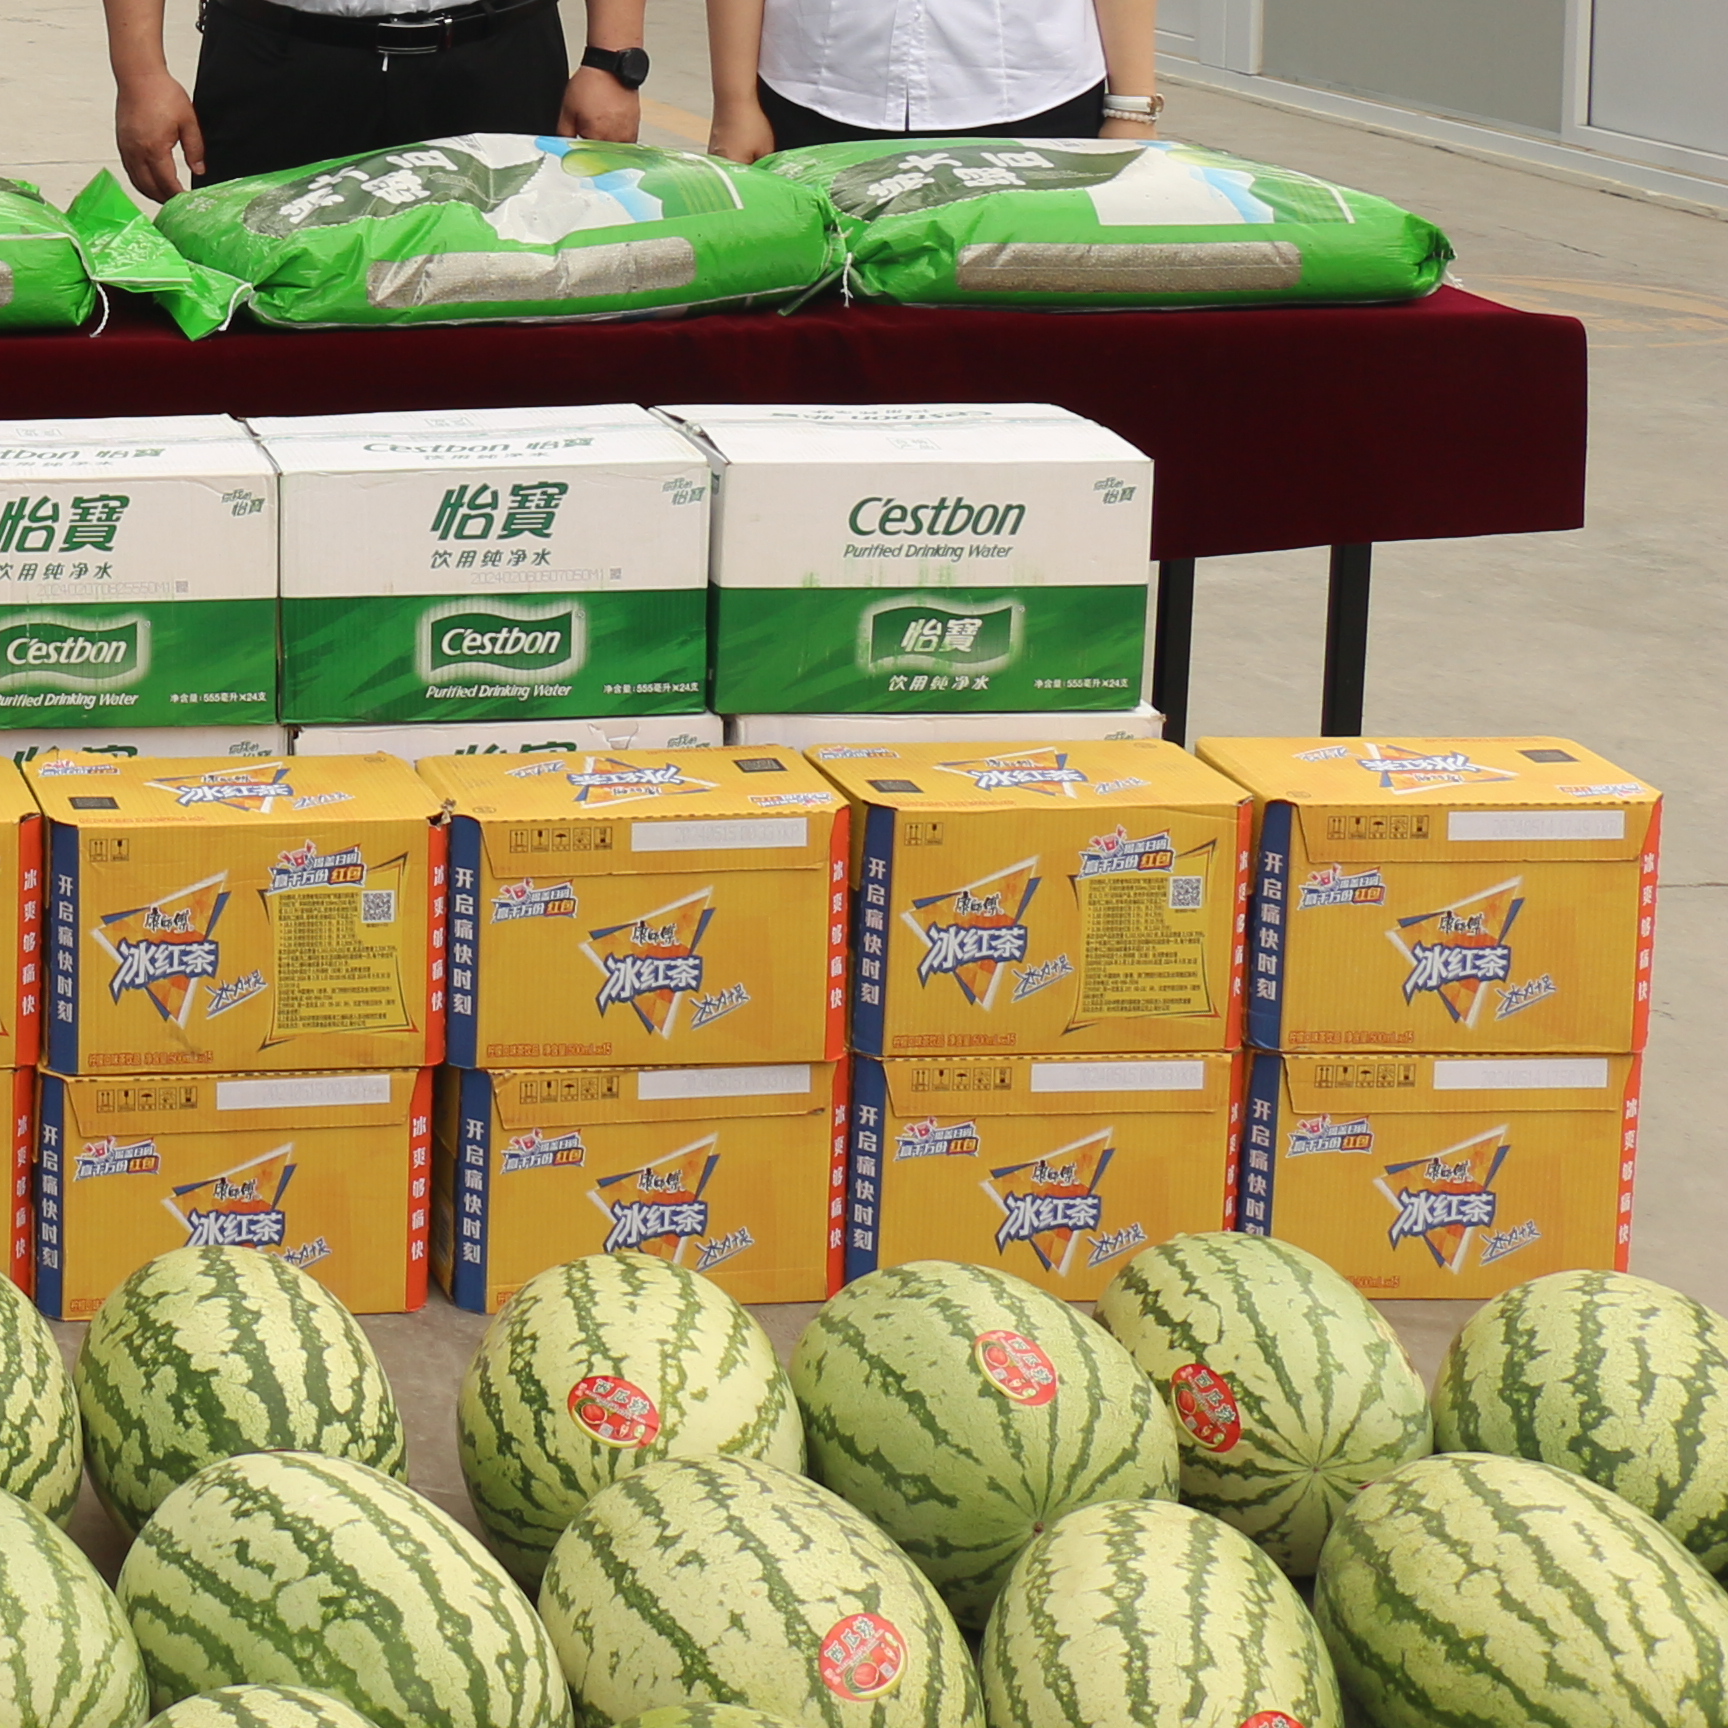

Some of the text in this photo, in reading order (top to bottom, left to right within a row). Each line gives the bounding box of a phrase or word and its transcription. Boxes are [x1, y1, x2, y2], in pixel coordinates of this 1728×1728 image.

[429, 481, 569, 542] 怡寶
[430, 548, 552, 570] 饮用纯净水
[843, 541, 1013, 563] Purified Drinking Water
[899, 618, 984, 653] 怡寶
[888, 673, 989, 692] 饮用纯净水
[1255, 852, 1284, 1001] 开启痛快时刻
[604, 957, 701, 1002] 冰红茶
[1407, 946, 1508, 990] 冰红茶
